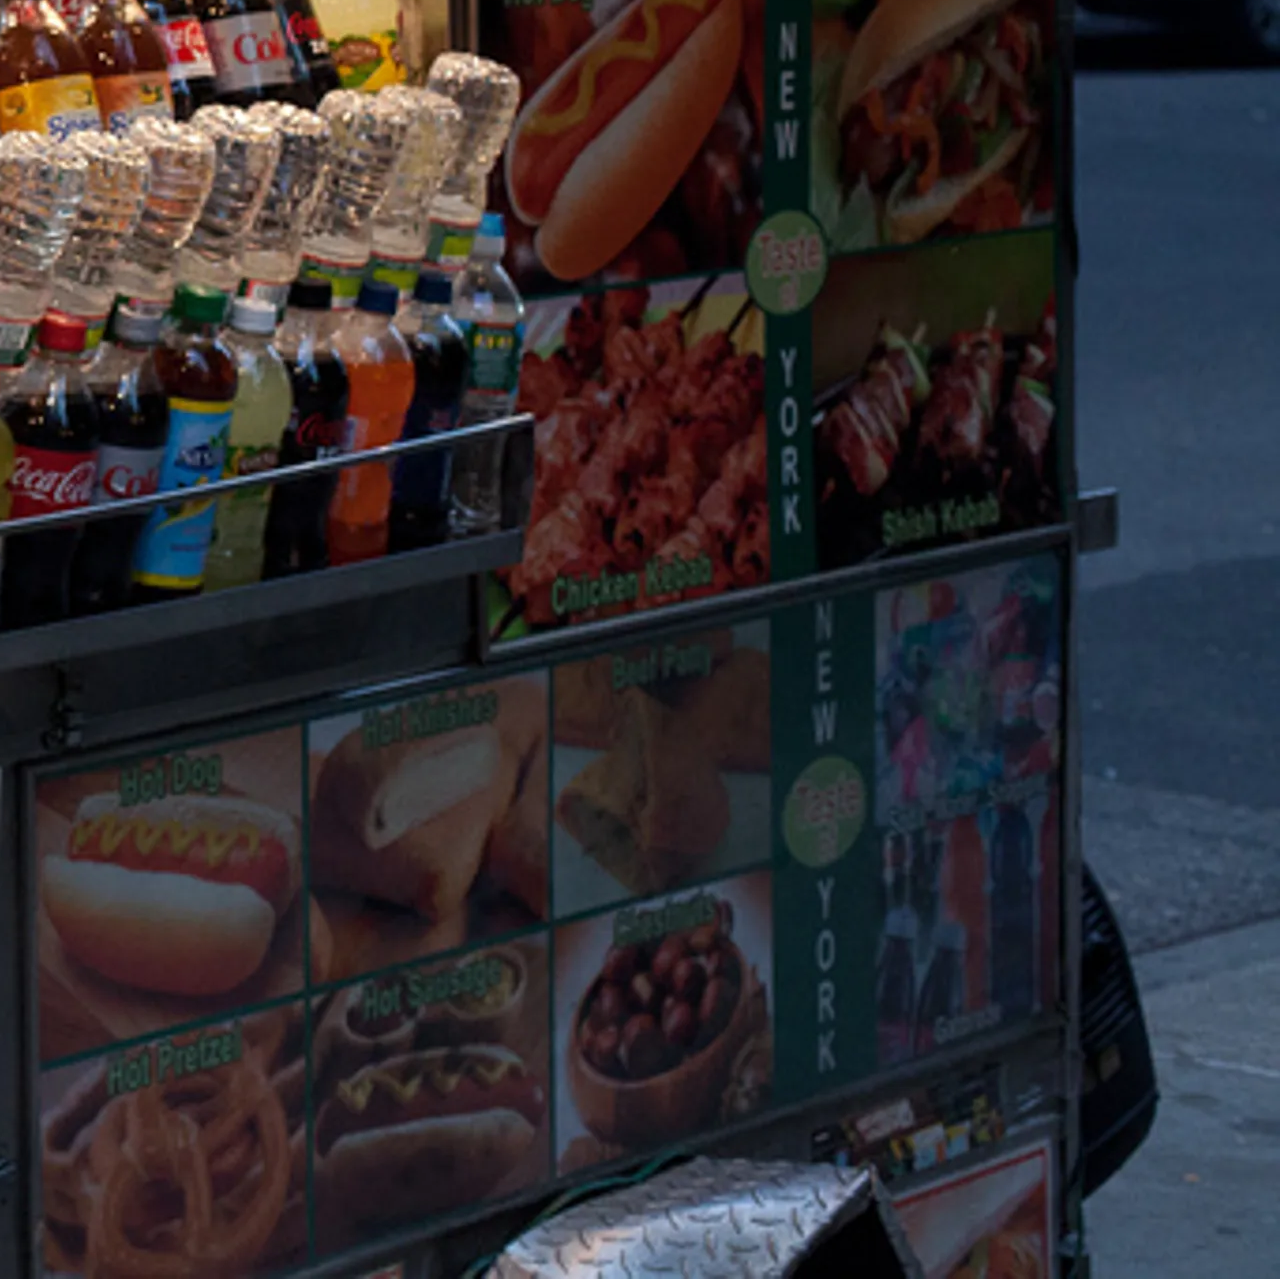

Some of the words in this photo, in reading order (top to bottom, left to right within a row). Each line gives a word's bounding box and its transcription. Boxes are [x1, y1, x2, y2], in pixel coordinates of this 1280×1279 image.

[773, 20, 802, 161] NEW
[778, 347, 803, 534] YORK
[941, 491, 1002, 534] Kebab
[551, 569, 639, 616] Chicken
[645, 551, 713, 596] Kebab
[120, 757, 167, 807] Hot
[171, 753, 223, 797] Dog
[362, 979, 406, 1022] Hot
[814, 877, 837, 1073] YORK
[107, 1052, 152, 1095] Hot
